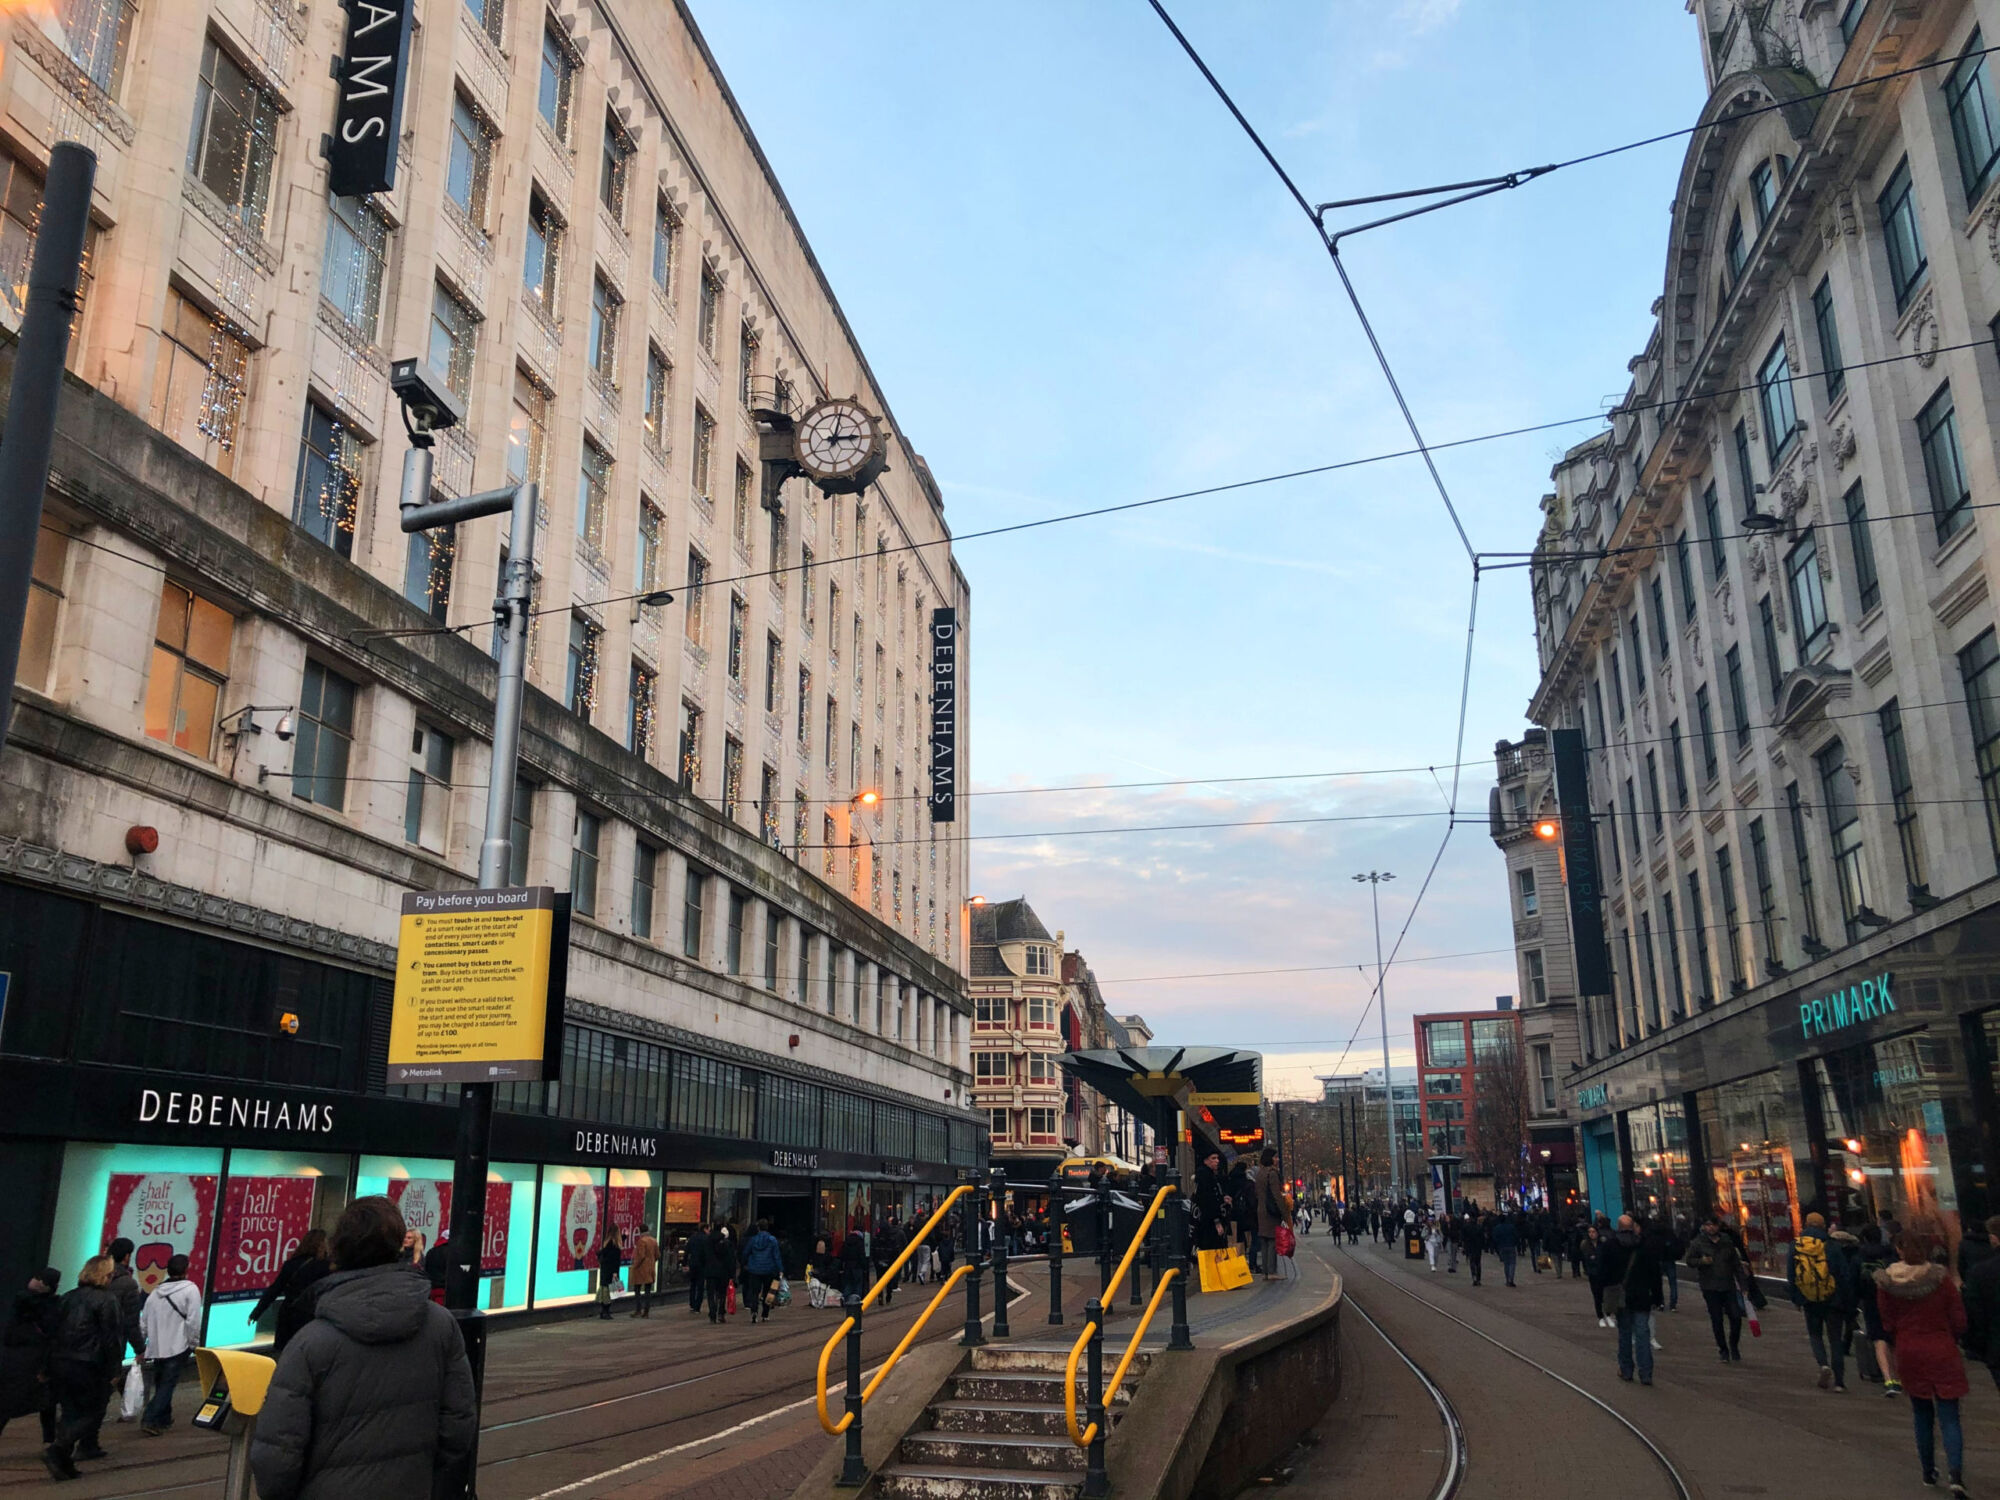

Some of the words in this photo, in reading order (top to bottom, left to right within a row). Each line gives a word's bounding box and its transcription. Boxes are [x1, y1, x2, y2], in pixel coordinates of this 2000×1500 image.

[342, 1, 396, 142] AMS
[936, 624, 953, 804] DEBENHAMS
[1569, 805, 1594, 913] PRIMARK
[416, 896, 435, 909] Pay
[438, 895, 472, 906] before
[474, 896, 494, 907] you
[497, 892, 528, 903] board
[1800, 972, 1895, 1040] PRIMARK
[139, 1090, 333, 1132] DEBENHAMS
[576, 1130, 657, 1157] DEBENHAMS
[774, 1151, 818, 1168] DEBENHAMS
[147, 1180, 173, 1199] half
[242, 1184, 282, 1214] half
[410, 1185, 425, 1199] half
[614, 1192, 631, 1212] half
[137, 1188, 147, 1228] winter
[142, 1202, 186, 1236] sale
[144, 1200, 169, 1213] price
[408, 1202, 434, 1227] sale
[575, 1202, 593, 1224] sale
[240, 1215, 277, 1239] price
[236, 1220, 300, 1275] sale
